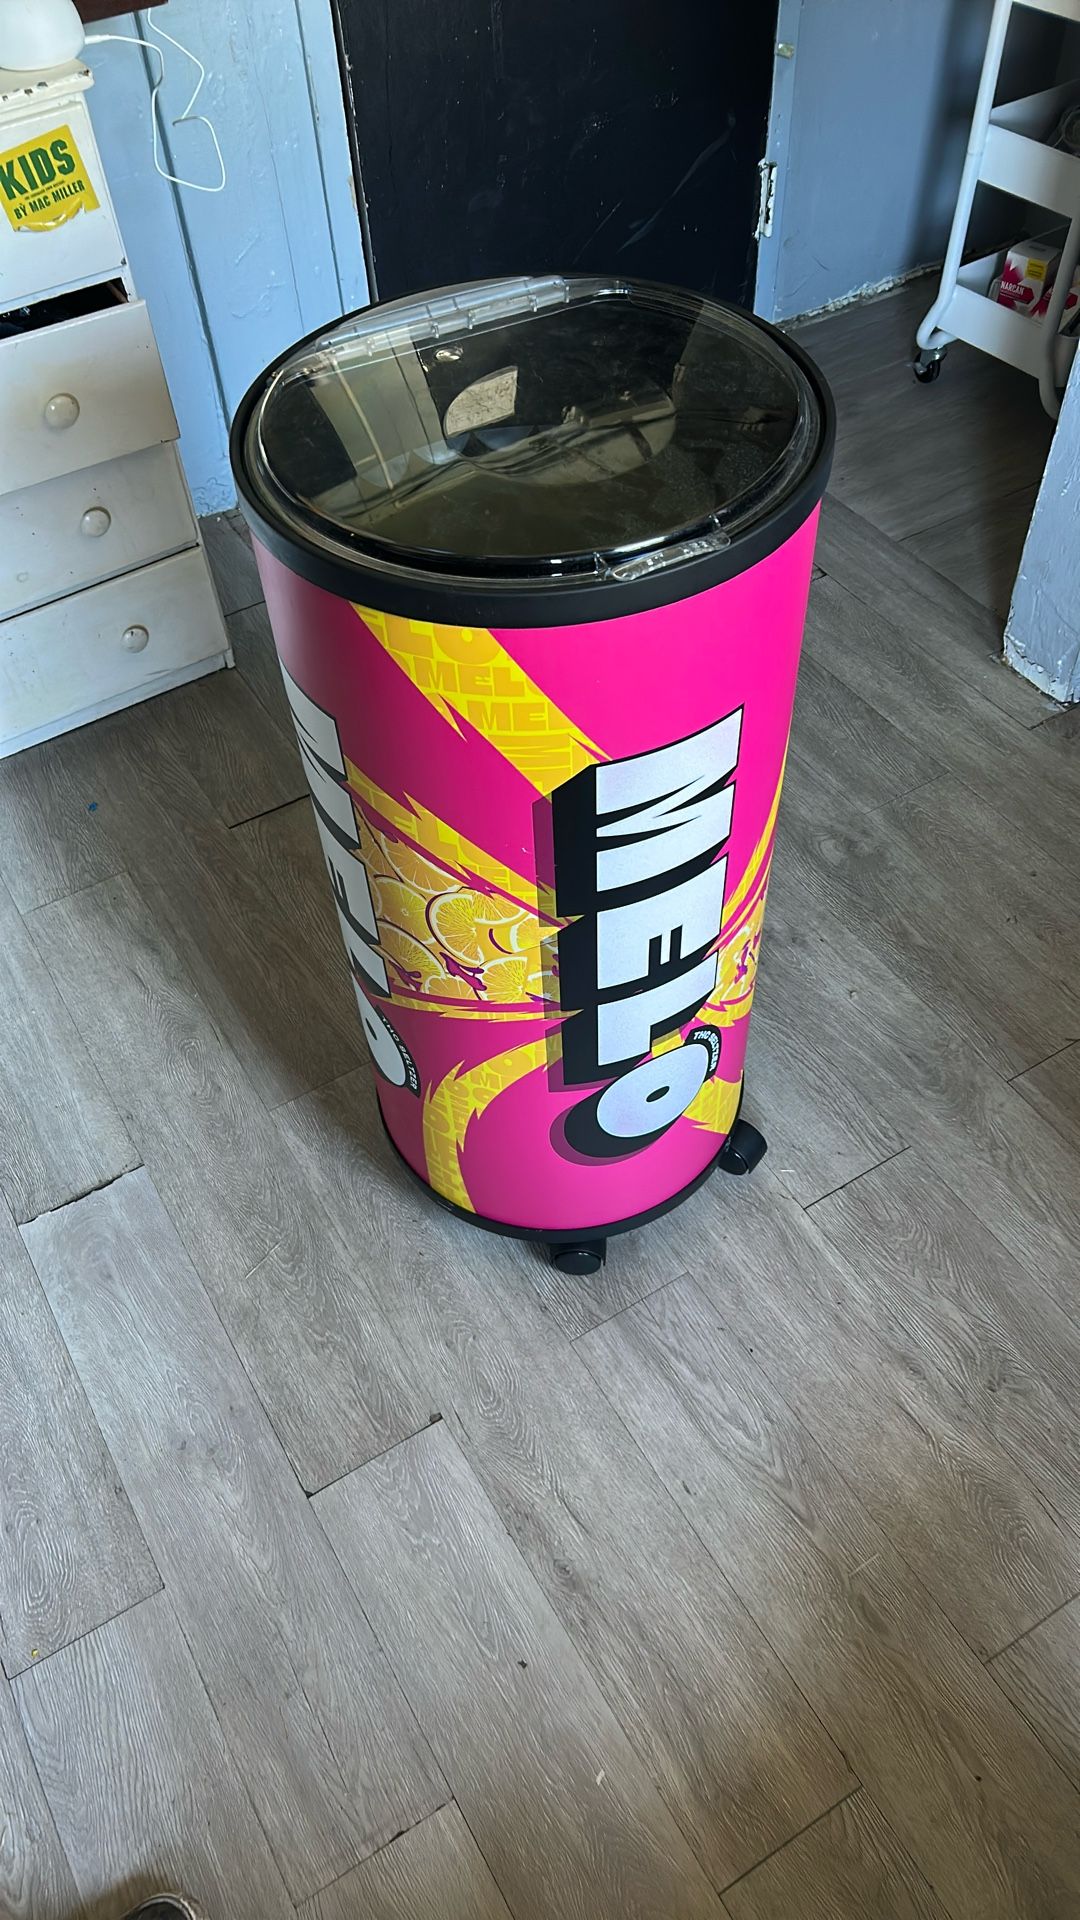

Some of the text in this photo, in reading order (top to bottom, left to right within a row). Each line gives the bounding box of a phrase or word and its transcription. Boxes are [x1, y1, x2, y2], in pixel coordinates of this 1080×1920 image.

[0, 139, 75, 200] KIDS
[14, 203, 27, 219] BY
[29, 195, 51, 213] MAC
[51, 179, 85, 203] MILLER
[1001, 281, 1025, 296] NARCAN
[597, 709, 743, 1137] MELO
[693, 1030, 711, 1040] THC
[708, 1032, 720, 1071] SELTZER
[399, 1045, 418, 1090] SELTZER
